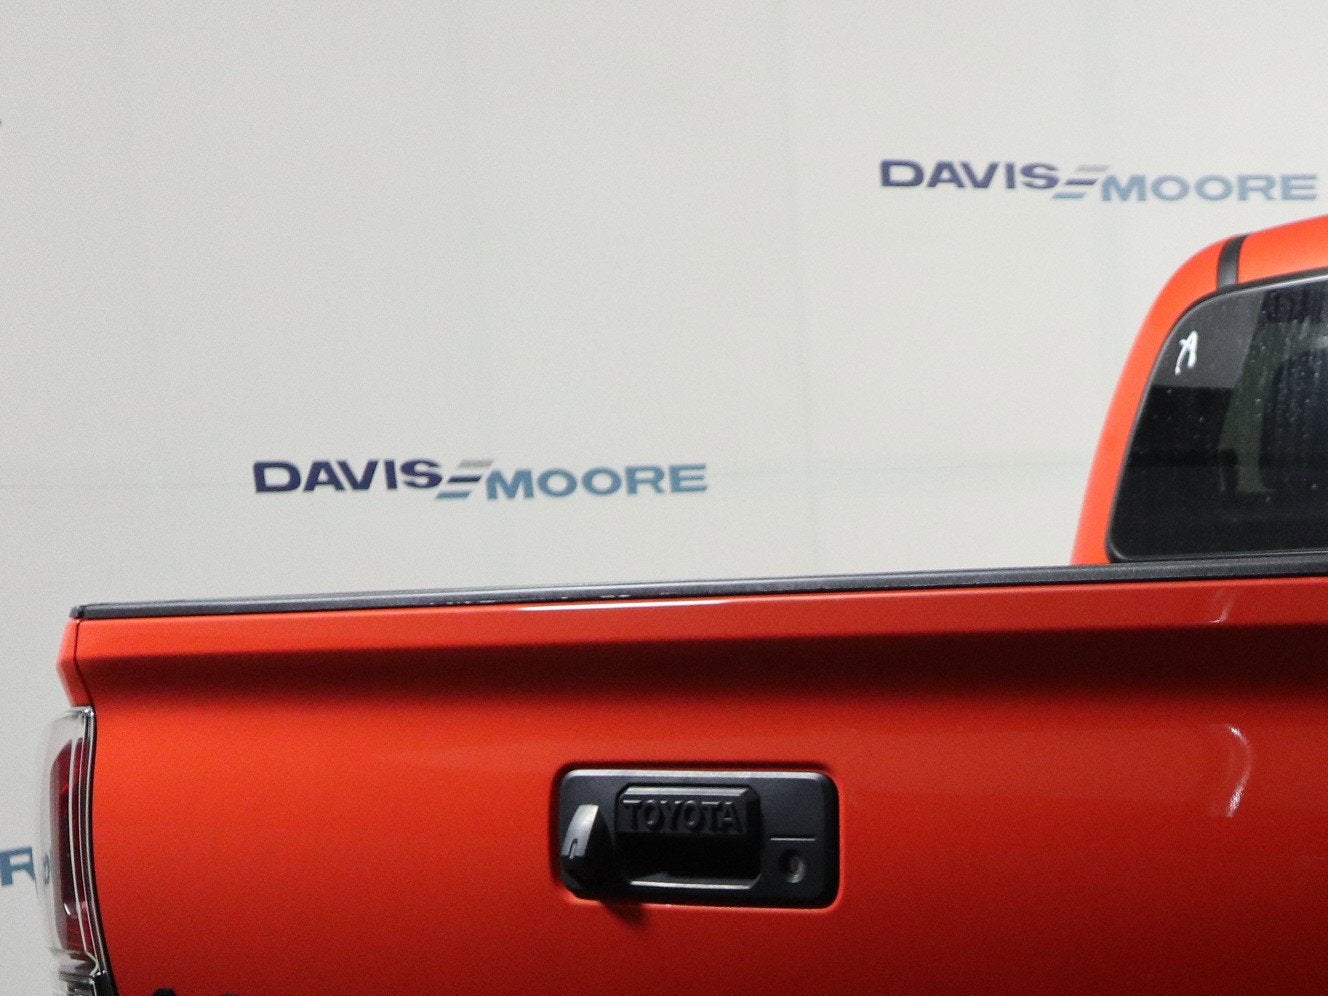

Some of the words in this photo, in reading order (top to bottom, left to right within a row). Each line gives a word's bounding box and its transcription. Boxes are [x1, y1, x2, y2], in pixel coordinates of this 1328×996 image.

[879, 158, 1060, 190] DAVIS
[1101, 173, 1318, 201] MOORE
[253, 458, 444, 494] DAVIS
[485, 462, 709, 500] MOORE
[622, 799, 744, 833] TOYOTA
